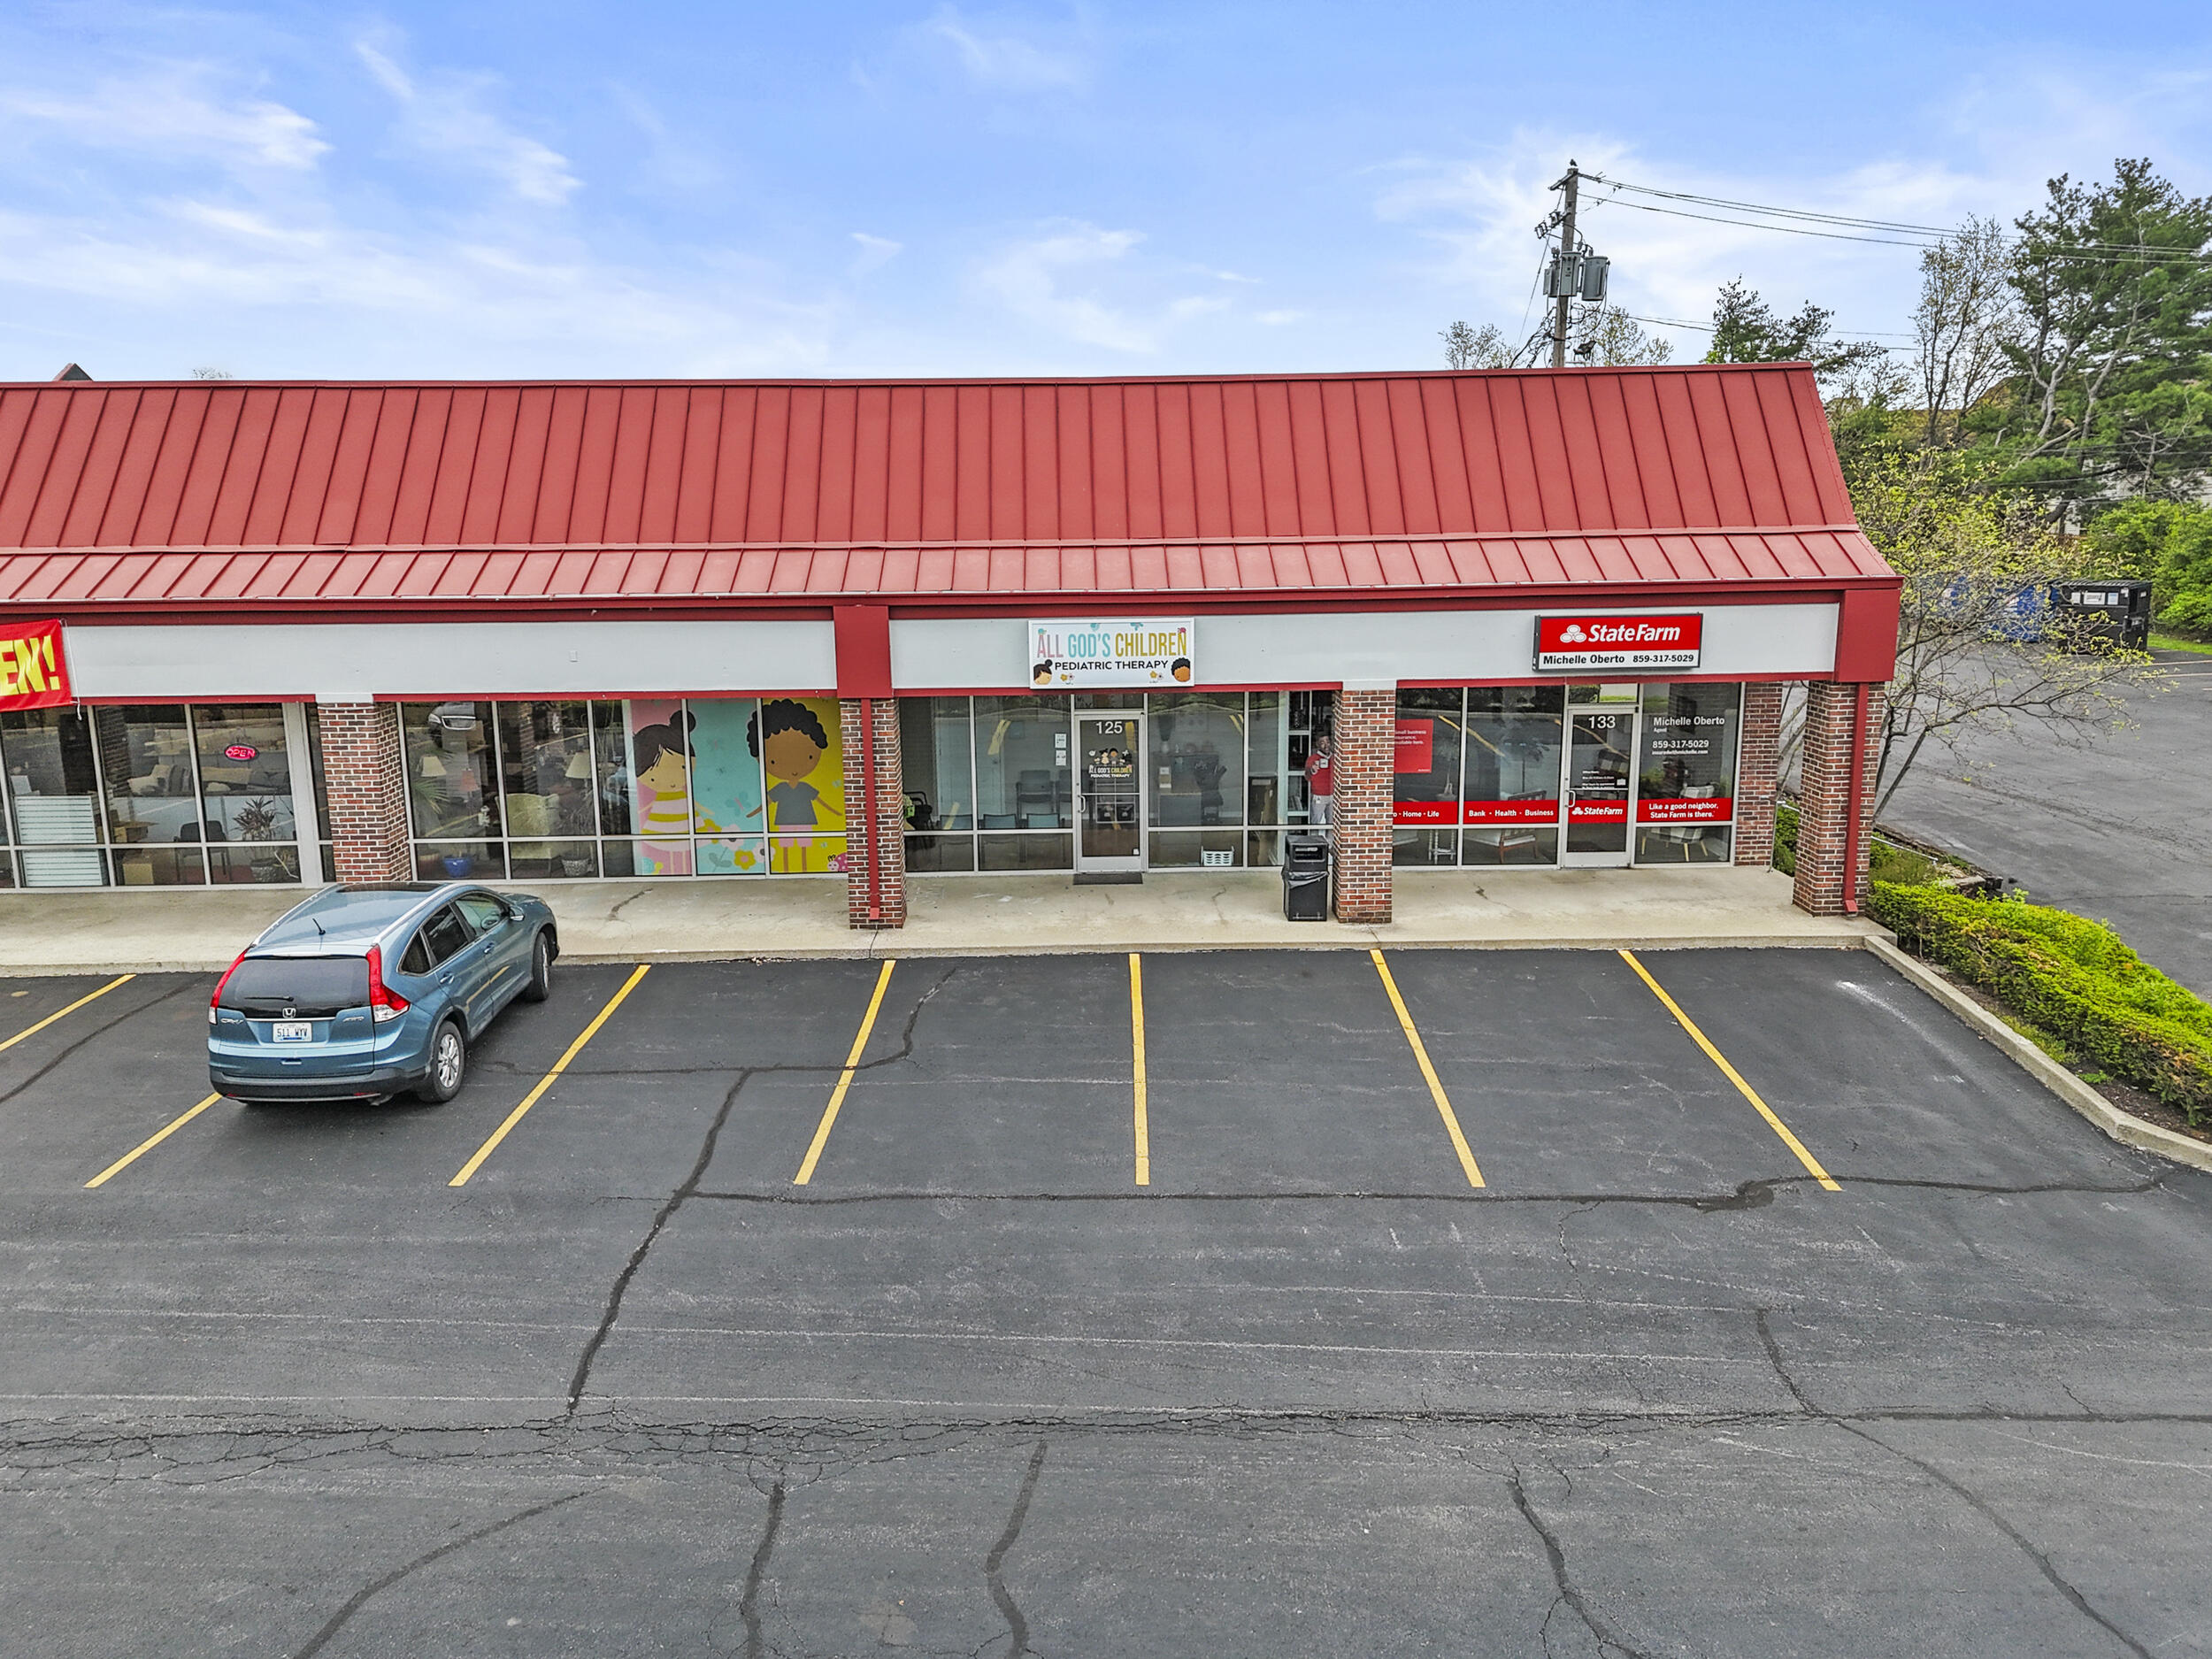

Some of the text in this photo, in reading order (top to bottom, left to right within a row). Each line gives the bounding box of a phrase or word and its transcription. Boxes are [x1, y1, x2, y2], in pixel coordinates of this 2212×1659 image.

[1037, 632, 1187, 658] ALL GOD'S CHILDREN
[1543, 654, 1694, 664] Michelle Oberto 859-317-5029
[1055, 660, 1168, 671] PEDIATRIC THERAPY
[1588, 715, 1616, 729] 133
[1653, 716, 1725, 726] Michelle Oberto
[1095, 721, 1123, 734] 125
[1652, 740, 1709, 749] 859-317-5029
[226, 749, 256, 758] OPEN
